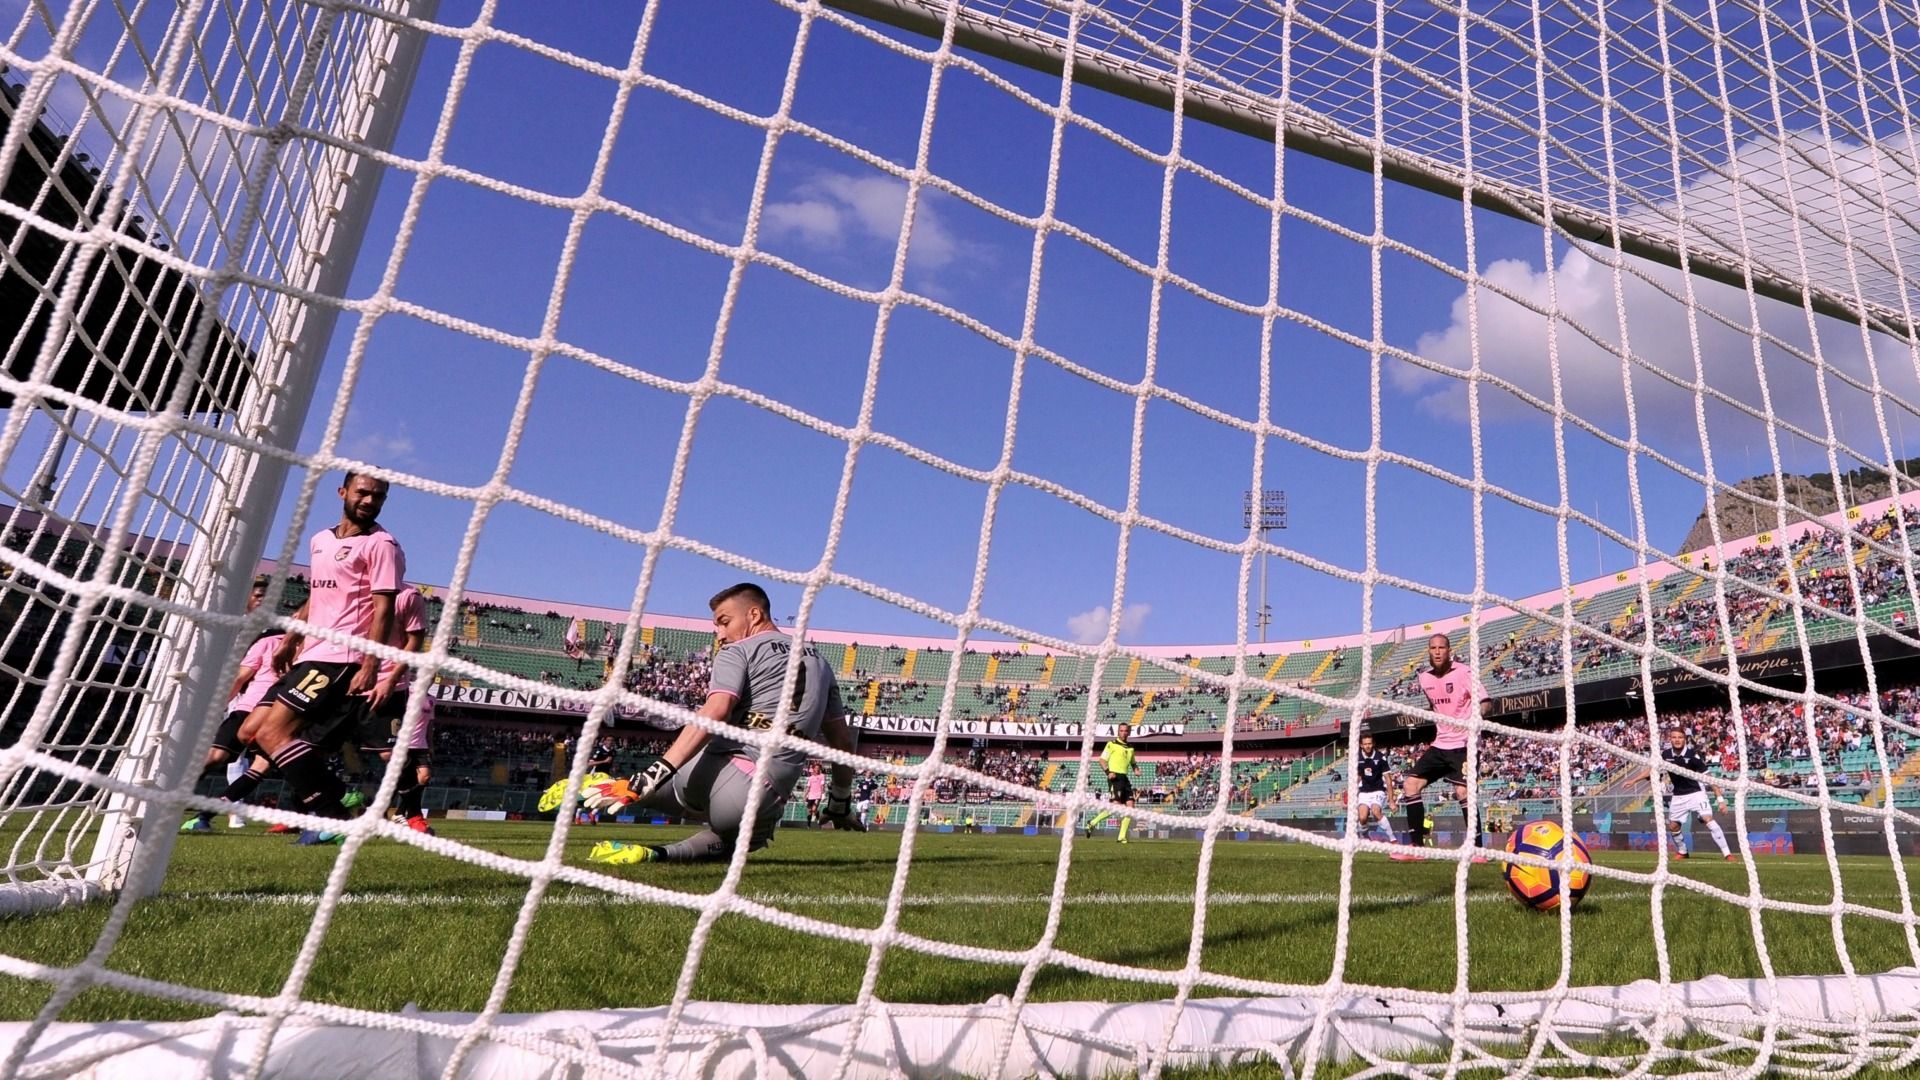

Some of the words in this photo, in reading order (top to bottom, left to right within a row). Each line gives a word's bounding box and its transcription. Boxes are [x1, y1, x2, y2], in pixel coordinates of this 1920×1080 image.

[296, 669, 330, 699] 12
[436, 684, 557, 711] PROFONDA
[1501, 690, 1550, 714] PRESIDENT
[986, 720, 1007, 734] LA
[1016, 723, 1059, 736] NAVE
[1066, 722, 1096, 736] CH
